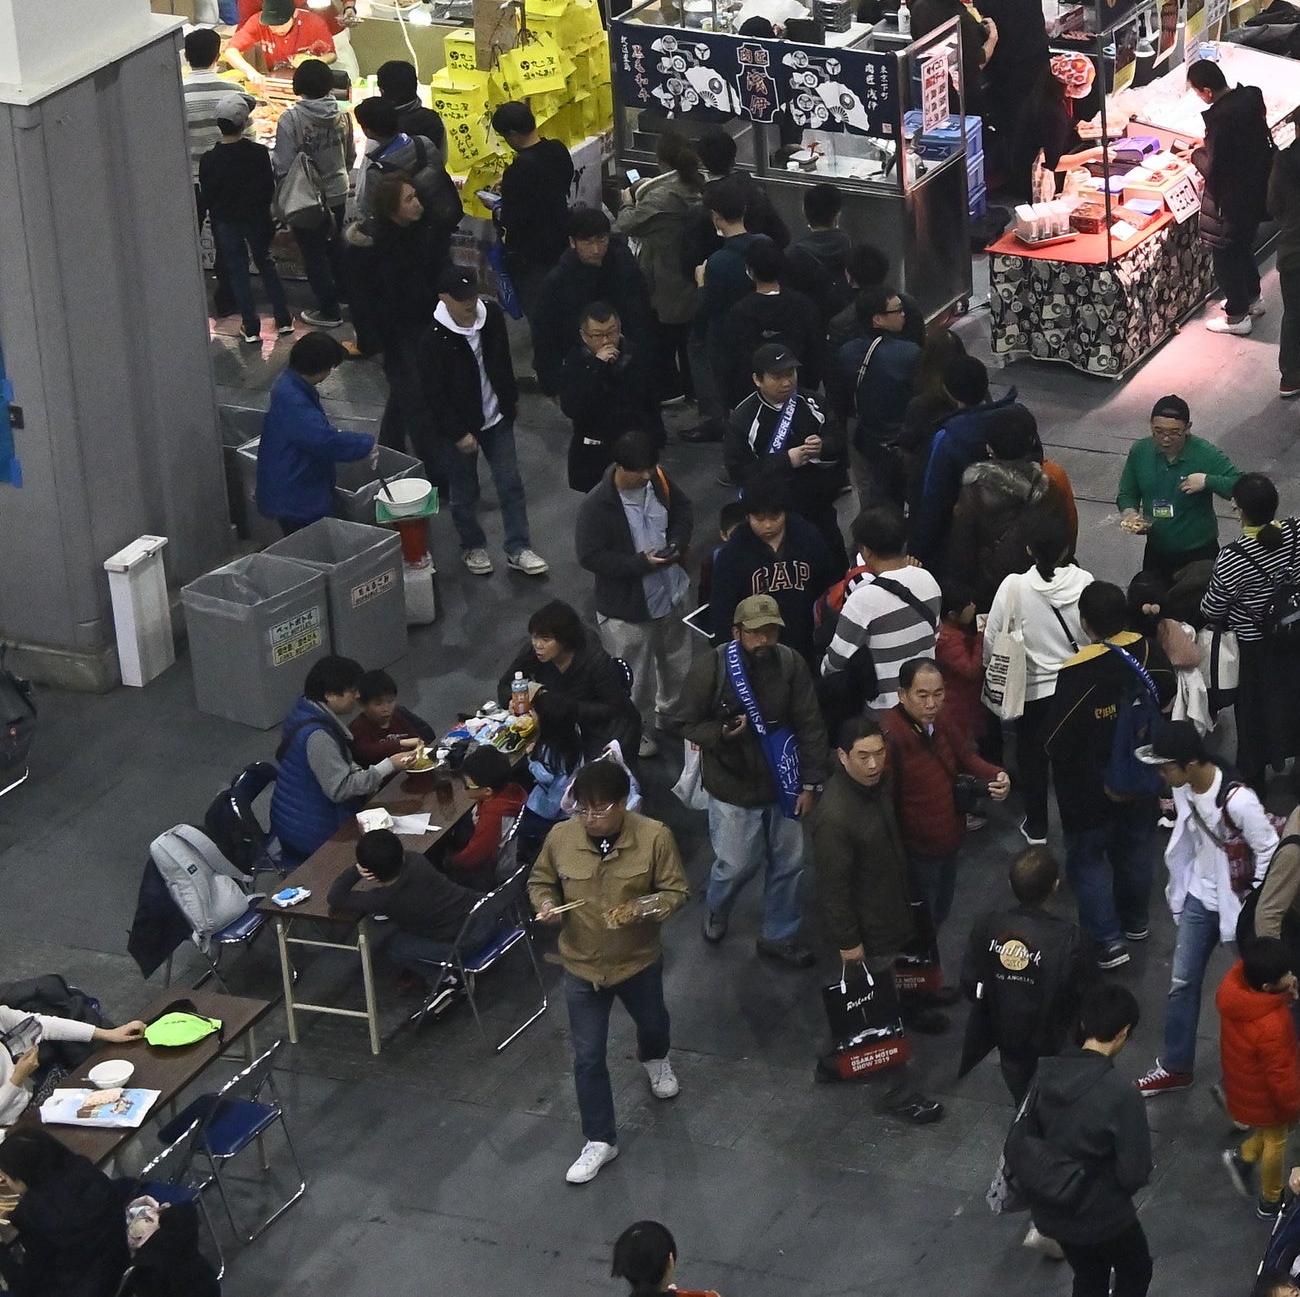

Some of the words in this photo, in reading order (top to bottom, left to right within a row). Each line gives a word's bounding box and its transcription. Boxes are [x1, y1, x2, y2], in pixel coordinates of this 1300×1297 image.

[772, 418, 790, 450] SPHERE
[784, 397, 797, 421] LIGHT
[751, 560, 811, 595] GAP
